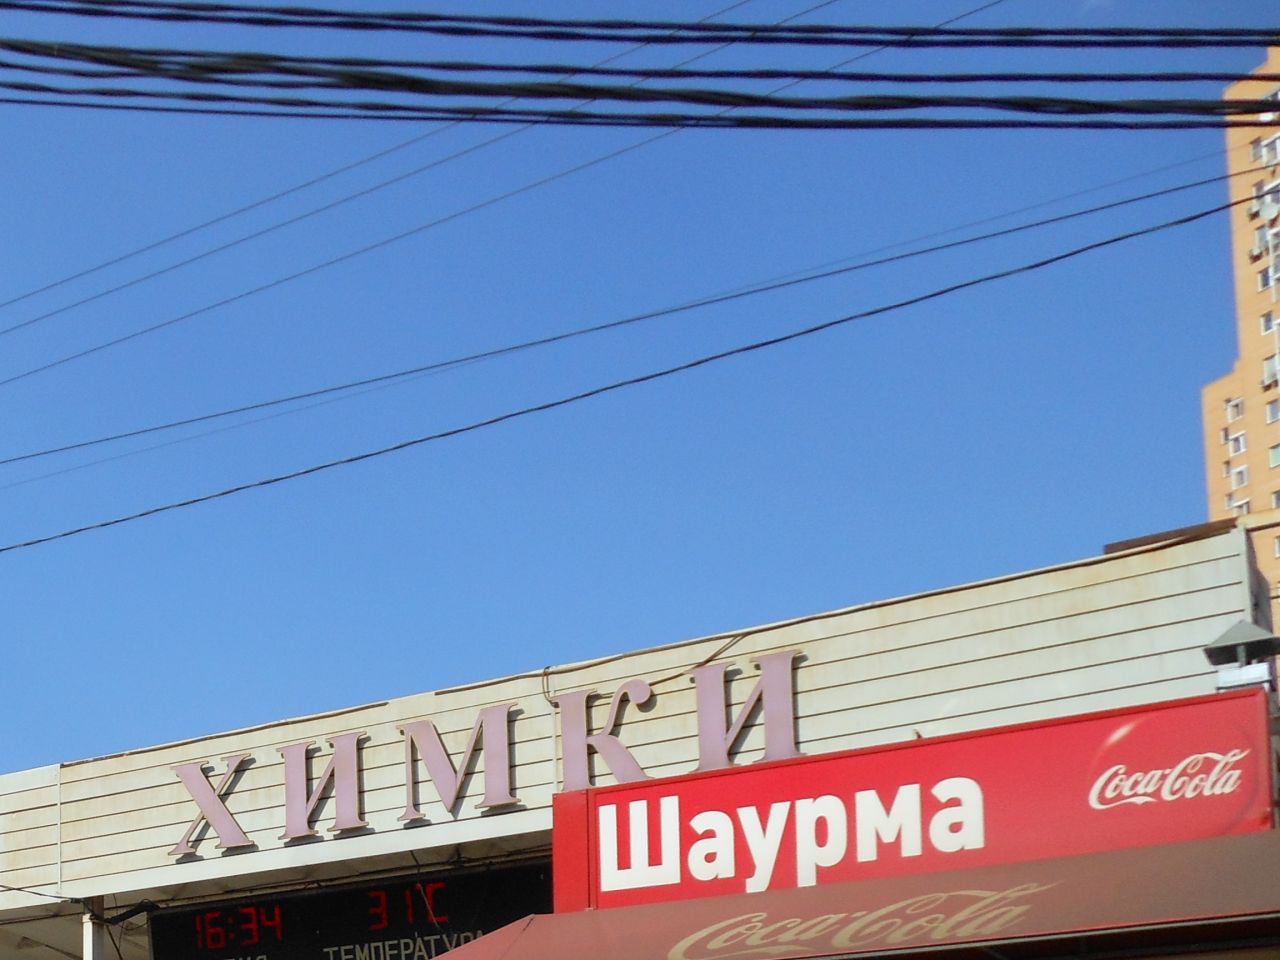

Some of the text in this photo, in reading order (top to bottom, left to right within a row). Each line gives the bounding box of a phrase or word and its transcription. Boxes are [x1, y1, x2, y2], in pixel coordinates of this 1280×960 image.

[168, 649, 809, 856] ХИМКИ
[1088, 749, 1252, 810] Coca-Cola
[597, 777, 985, 893] Шаурма
[195, 904, 283, 949] 16:34
